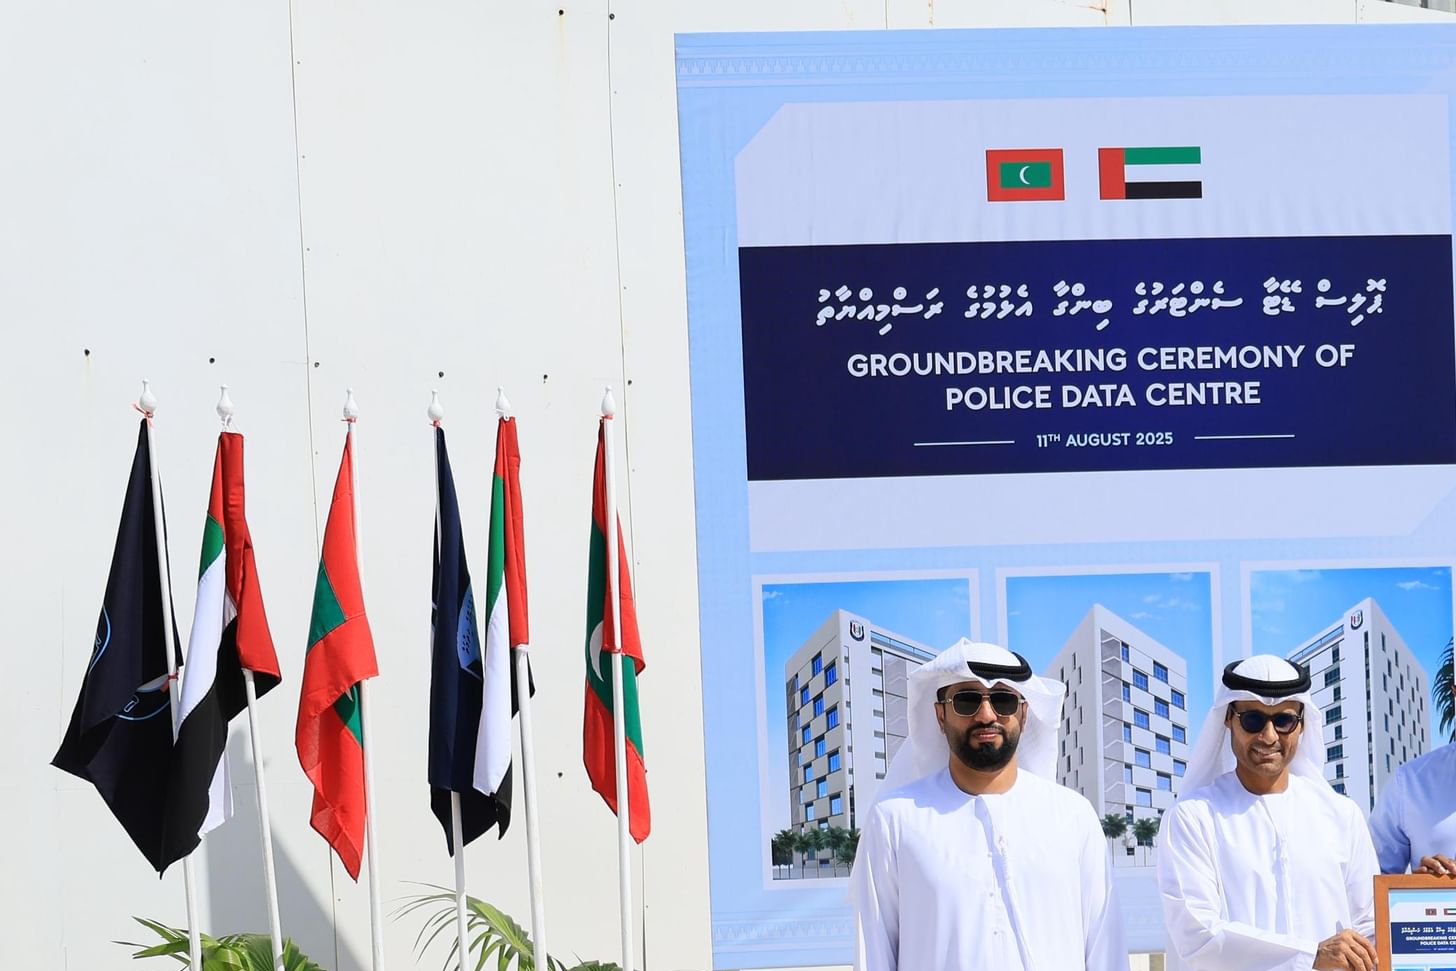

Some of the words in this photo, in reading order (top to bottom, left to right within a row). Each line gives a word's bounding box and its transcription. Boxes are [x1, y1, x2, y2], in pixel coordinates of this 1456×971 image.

[815, 284, 944, 336] ރަސްމިއްޔާތު
[964, 283, 1033, 320] އެޅުމުގެ
[1052, 280, 1113, 331] ބިންގާ
[1132, 280, 1243, 317] ސެންޓަރުގެ
[1262, 276, 1303, 316] ޑޭޓާ
[1315, 278, 1387, 327] ޕޮލިސް
[847, 347, 1127, 378] GROUNDBREAKING
[1137, 344, 1306, 371] CEREMONY
[1315, 344, 1356, 368] OF
[946, 385, 1052, 411] POLICE
[1061, 383, 1137, 408] DATA
[1145, 381, 1261, 406] CENTRE
[1036, 433, 1061, 448] 11TH
[1065, 432, 1131, 447] AUGUST
[1135, 431, 1174, 446] 2025
